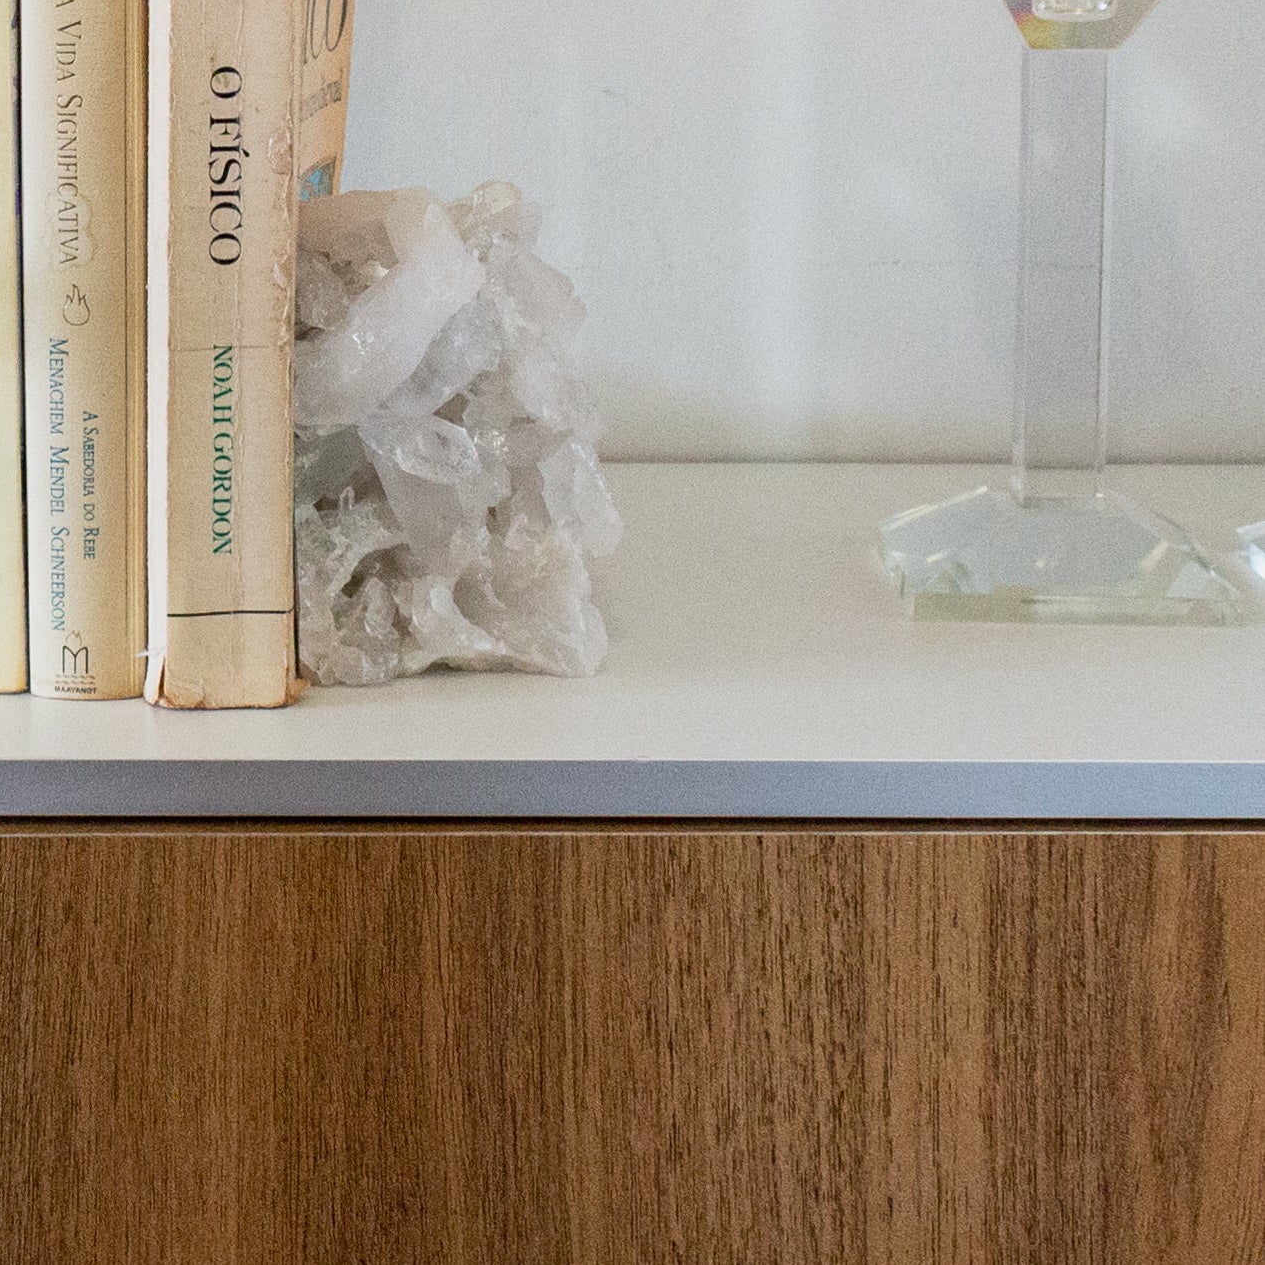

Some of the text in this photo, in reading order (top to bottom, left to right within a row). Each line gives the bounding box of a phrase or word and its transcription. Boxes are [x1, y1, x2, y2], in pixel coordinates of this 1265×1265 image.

[55, 19, 82, 82] VIDA
[56, 94, 84, 265] SIGNIFICATIVA
[208, 66, 251, 266] O FÍSICO
[82, 410, 99, 422] A
[83, 427, 100, 498] SABEDORIA
[211, 344, 234, 554] NOAH GORDON
[48, 337, 70, 632] MENACHEM MENDEL SCHNEERSON
[83, 504, 96, 522] DO
